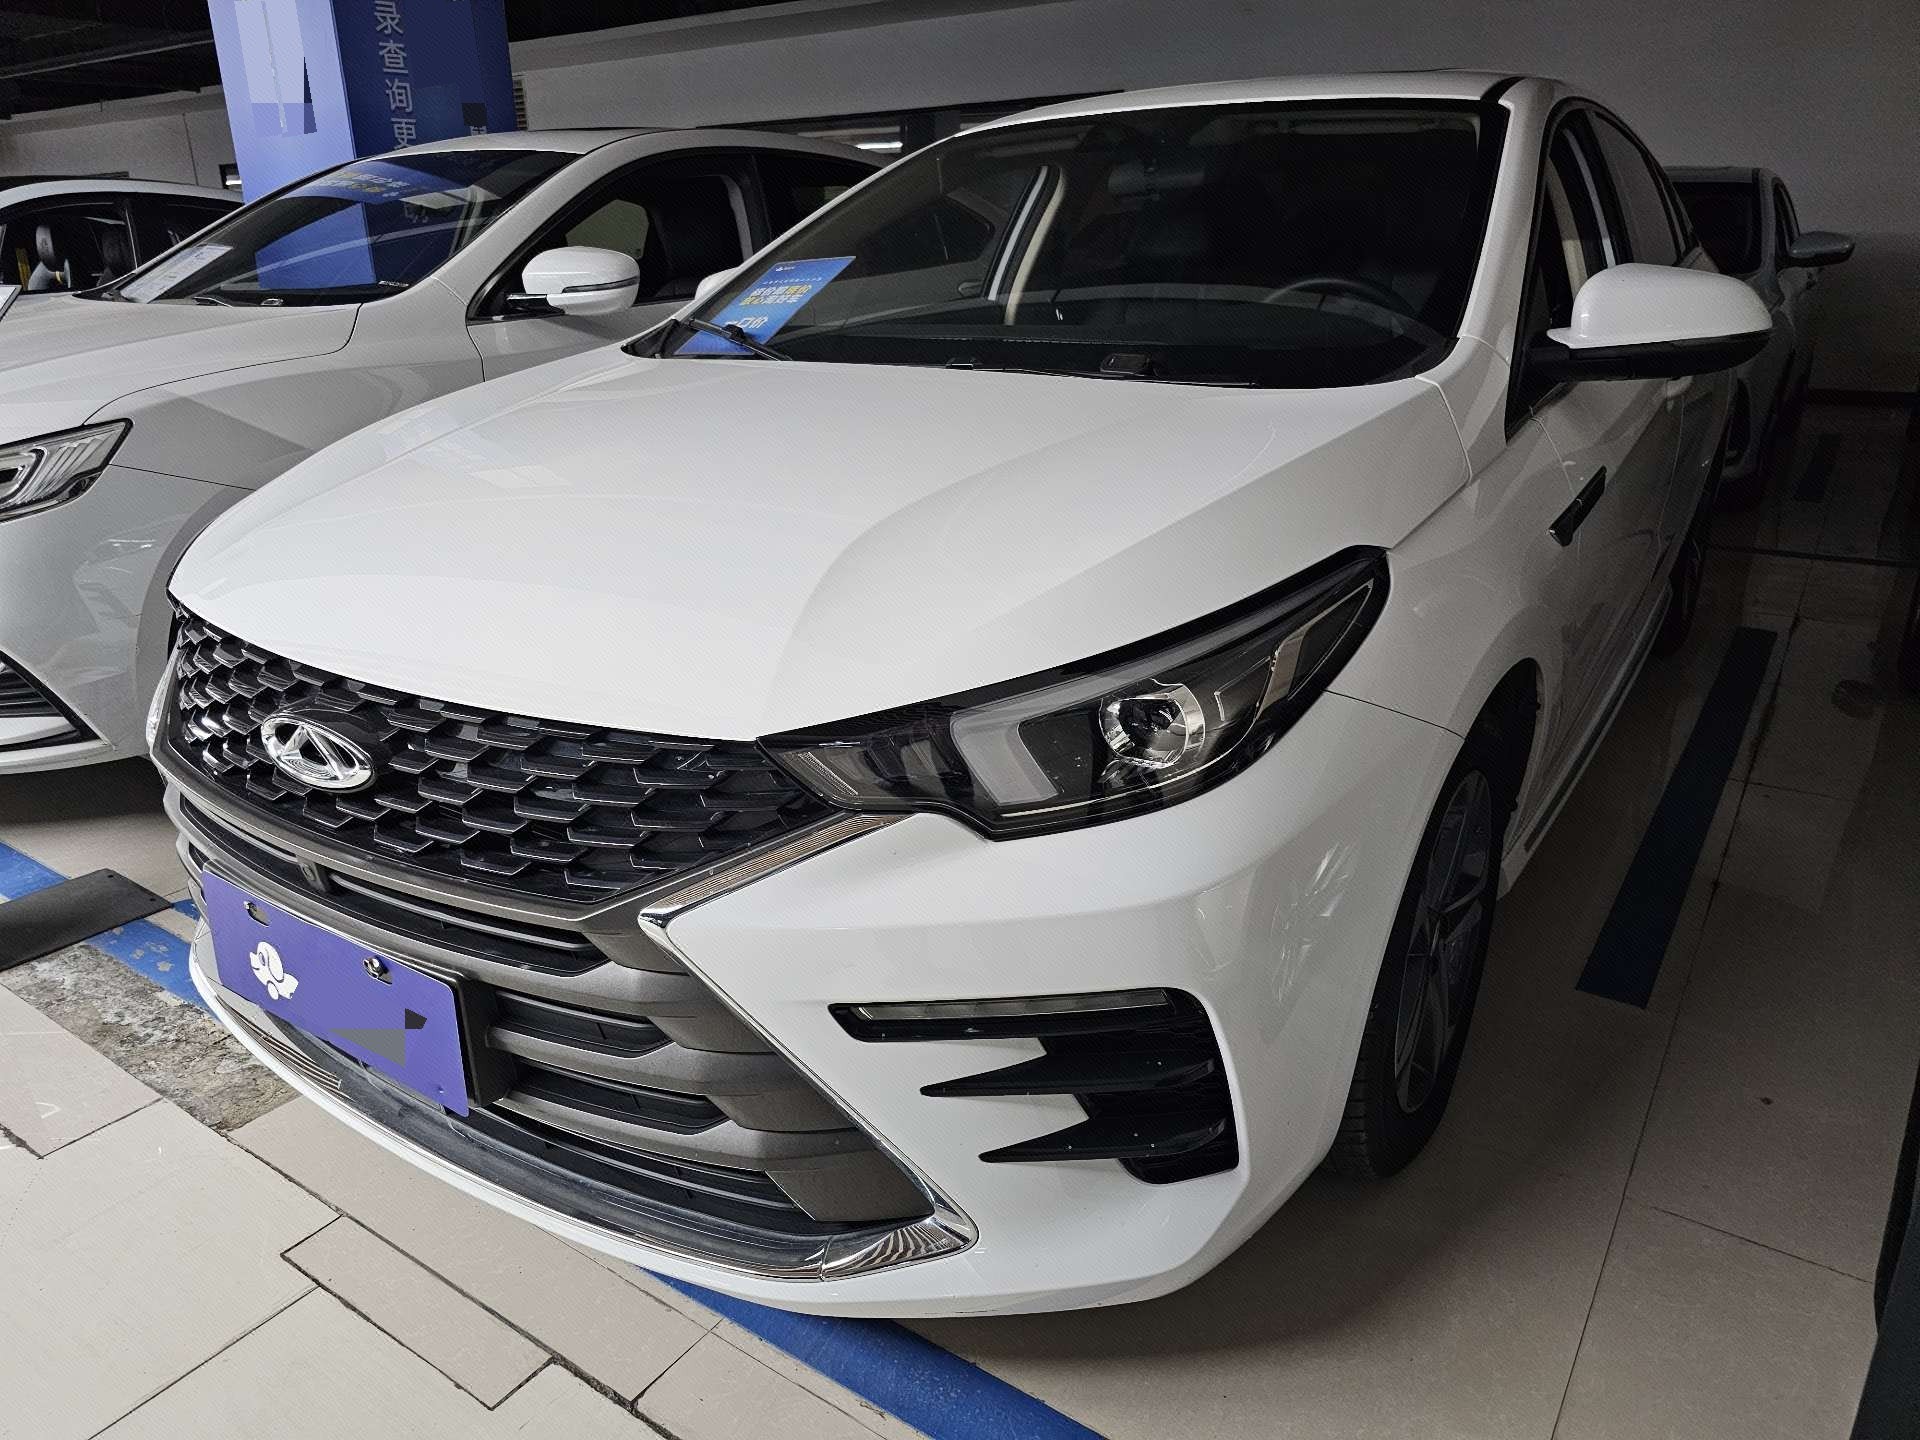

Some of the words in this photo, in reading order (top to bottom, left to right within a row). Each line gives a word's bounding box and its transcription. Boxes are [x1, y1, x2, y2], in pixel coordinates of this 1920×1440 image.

[374, 0, 416, 149] 录查询更
[726, 315, 768, 328] 一口价
